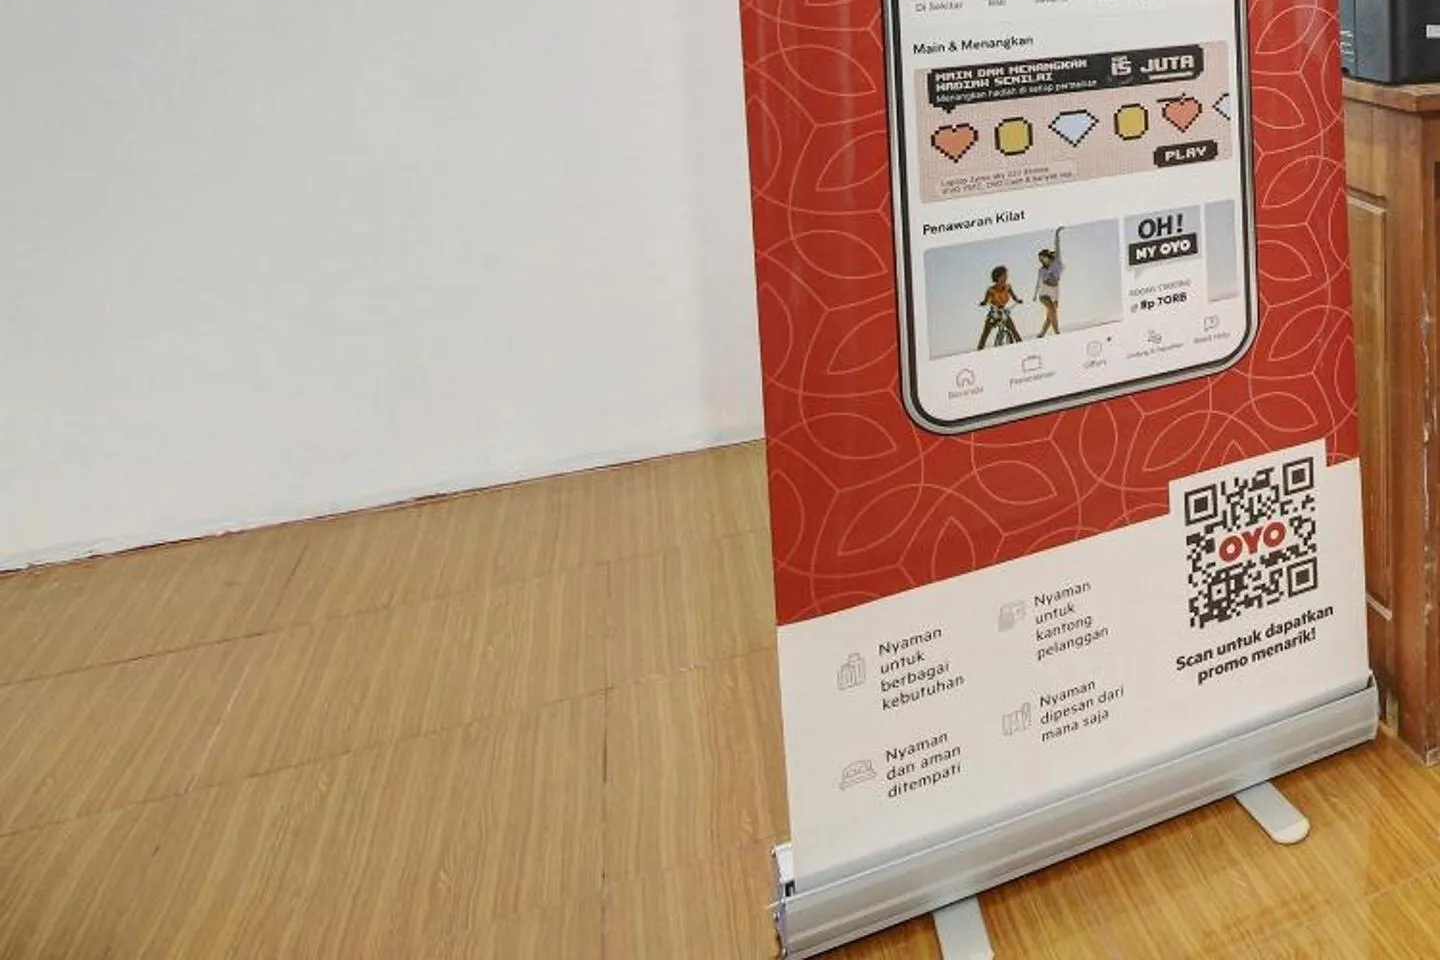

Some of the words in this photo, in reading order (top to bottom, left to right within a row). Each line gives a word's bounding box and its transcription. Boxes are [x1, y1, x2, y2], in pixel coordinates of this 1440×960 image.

[913, 43, 945, 54] Main
[948, 43, 957, 52] &
[962, 36, 1033, 51] Menangkan
[936, 70, 972, 81] MAIN
[1140, 55, 1194, 73] JUTA
[1165, 146, 1207, 161] PLAY
[923, 217, 993, 235] Penawaran
[996, 211, 1025, 223] Kilat
[1138, 214, 1183, 239] OH!
[1136, 245, 1157, 259] MY
[1160, 240, 1191, 254] OYO
[1219, 521, 1286, 563] OYO
[1034, 580, 1091, 608] Nyaman
[1036, 603, 1075, 624] untuk
[878, 627, 942, 655] Nyaman
[1036, 615, 1092, 641] kantong
[1176, 648, 1213, 670] Scan
[1217, 631, 1261, 657] untuk
[1265, 606, 1333, 638] dapatkan
[1037, 627, 1108, 661] pelanggan
[1198, 655, 1248, 685] promo
[1251, 627, 1316, 663] menarik!
[880, 650, 925, 673] untuk
[880, 663, 949, 691] berbagai
[882, 675, 964, 711] kebutuhan
[1040, 679, 1095, 707] Nyaman
[1040, 698, 1093, 725] dipesan
[1098, 685, 1124, 704] dari
[1042, 722, 1078, 742] mana
[1083, 709, 1109, 730] saja
[886, 731, 947, 762] Nyaman
[886, 761, 915, 780] dan
[921, 745, 961, 769] aman
[888, 764, 961, 798] ditempati
